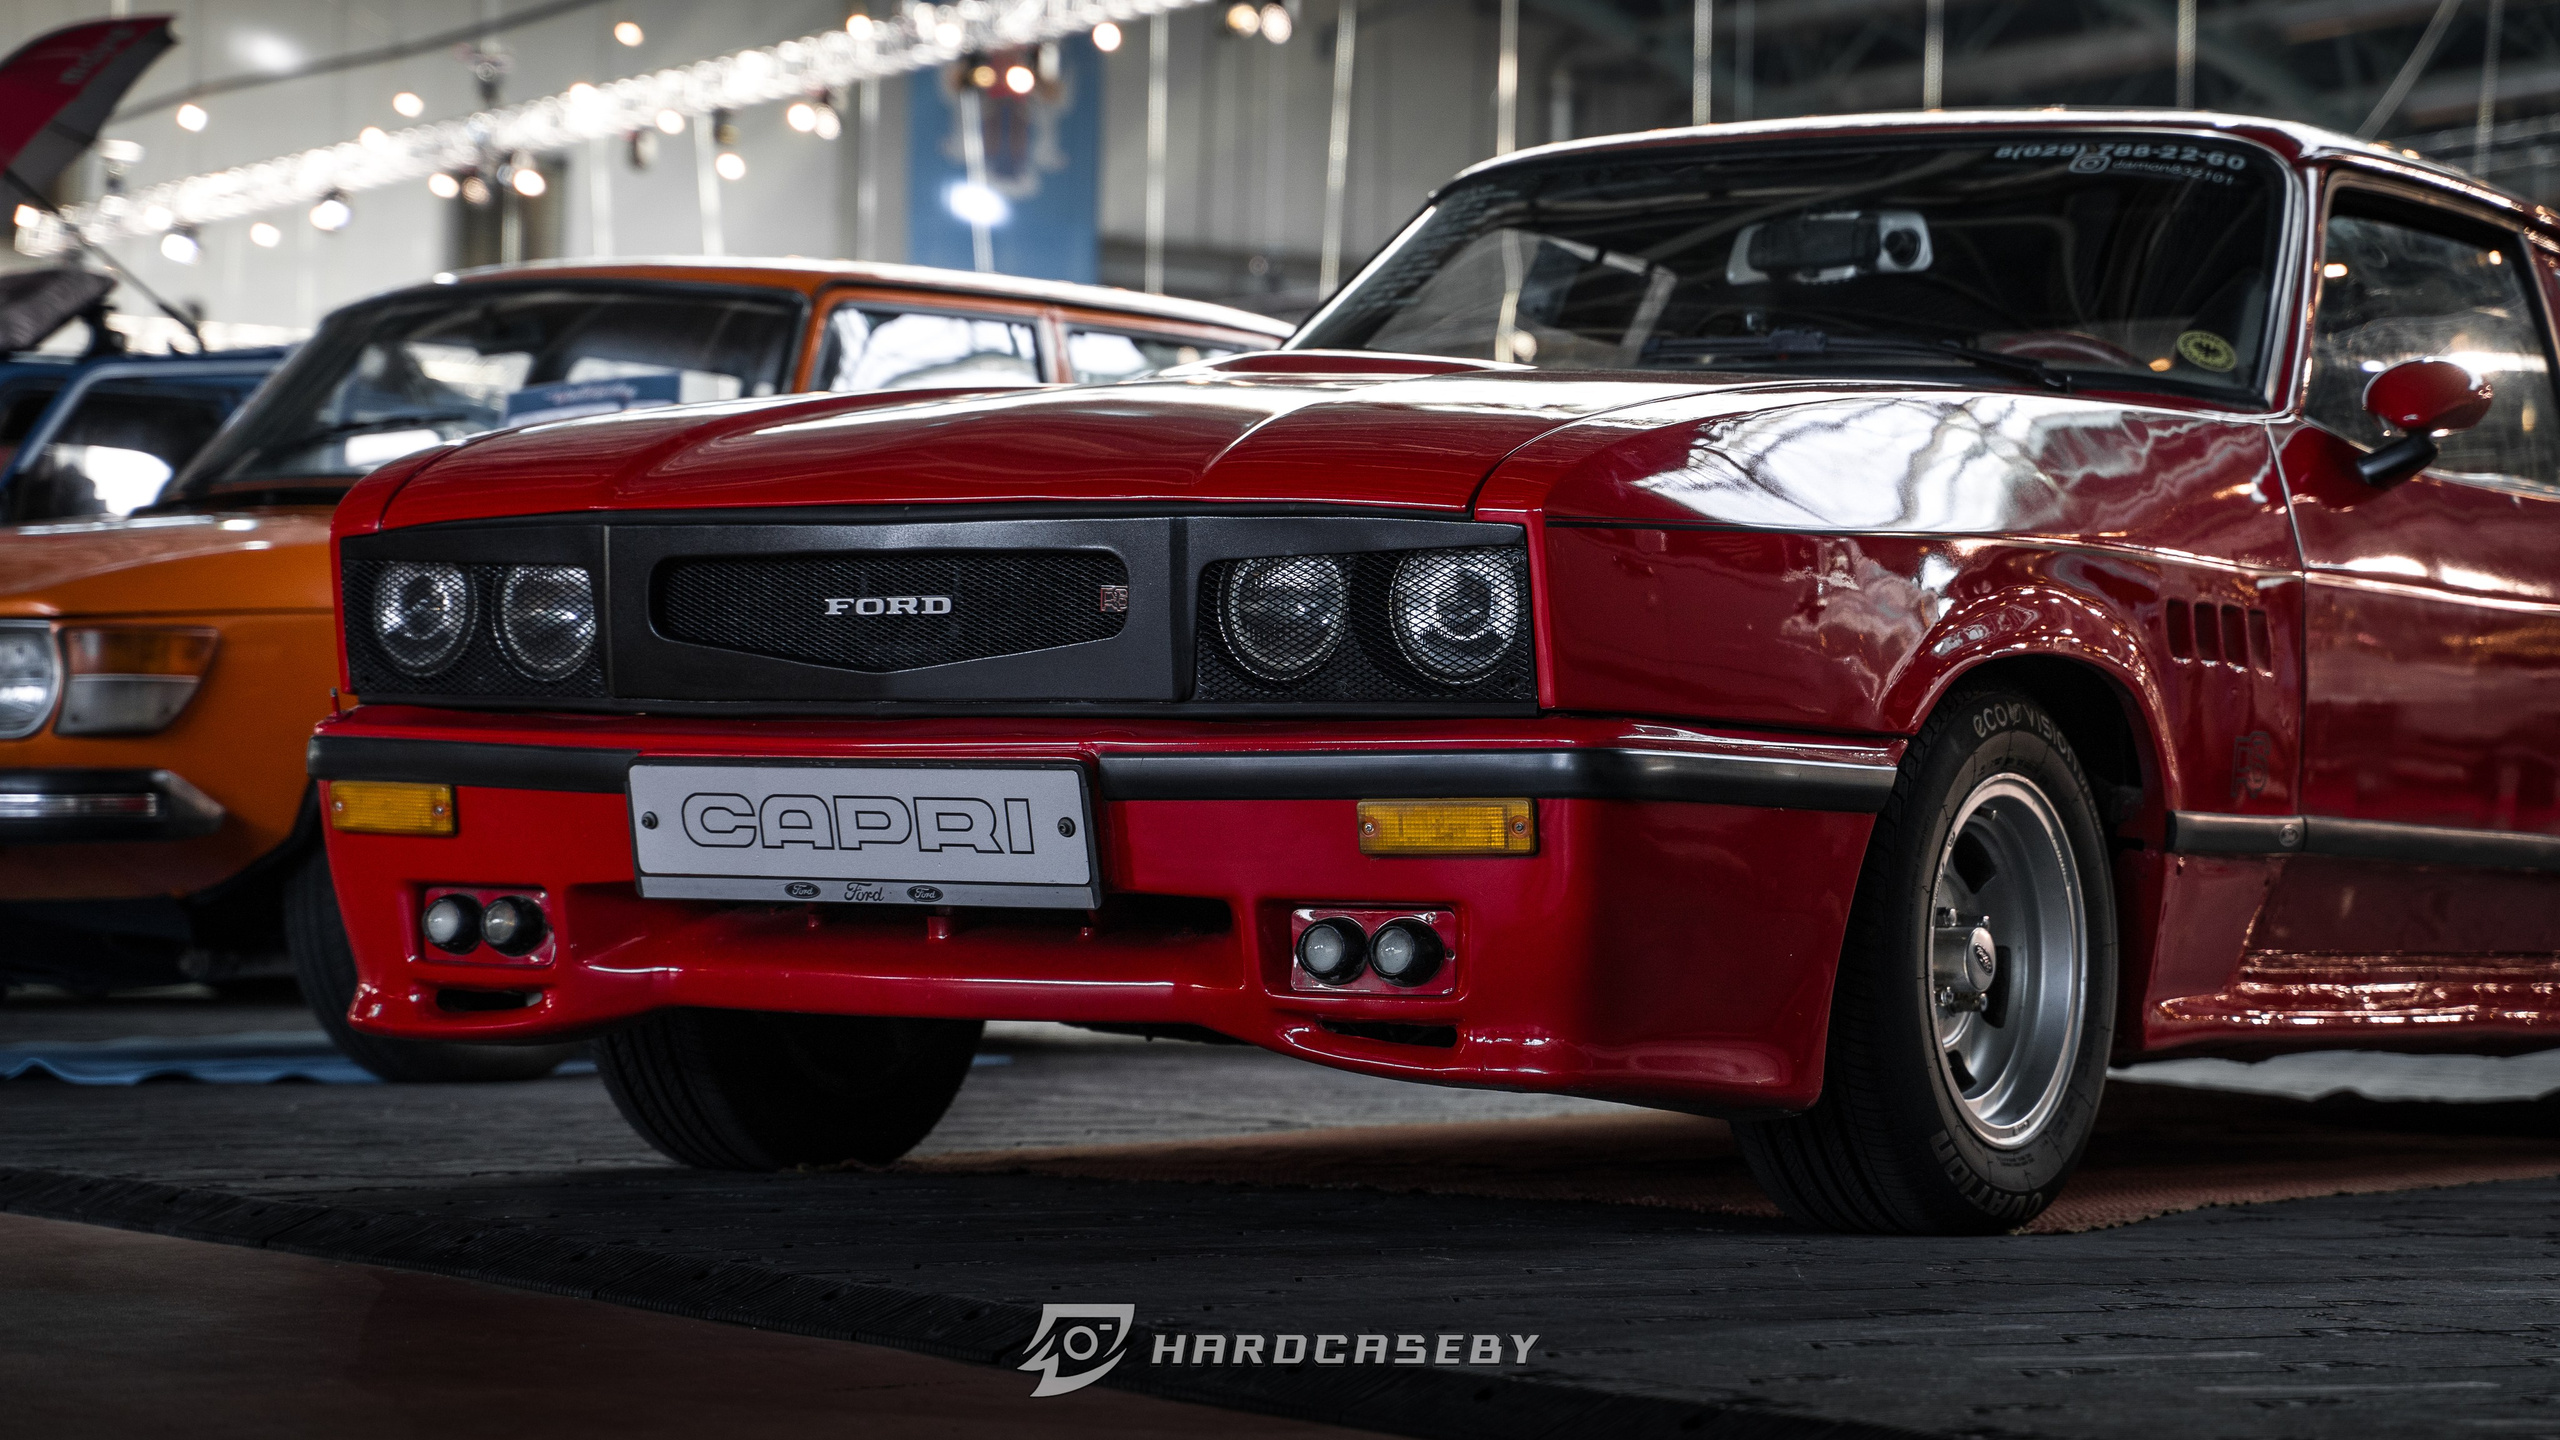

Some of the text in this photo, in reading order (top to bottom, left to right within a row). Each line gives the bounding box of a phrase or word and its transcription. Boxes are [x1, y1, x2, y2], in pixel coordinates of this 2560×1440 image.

[824, 596, 951, 616] FORD
[681, 792, 1035, 855] CAPRI
[791, 881, 937, 903] Ford Ford Ford
